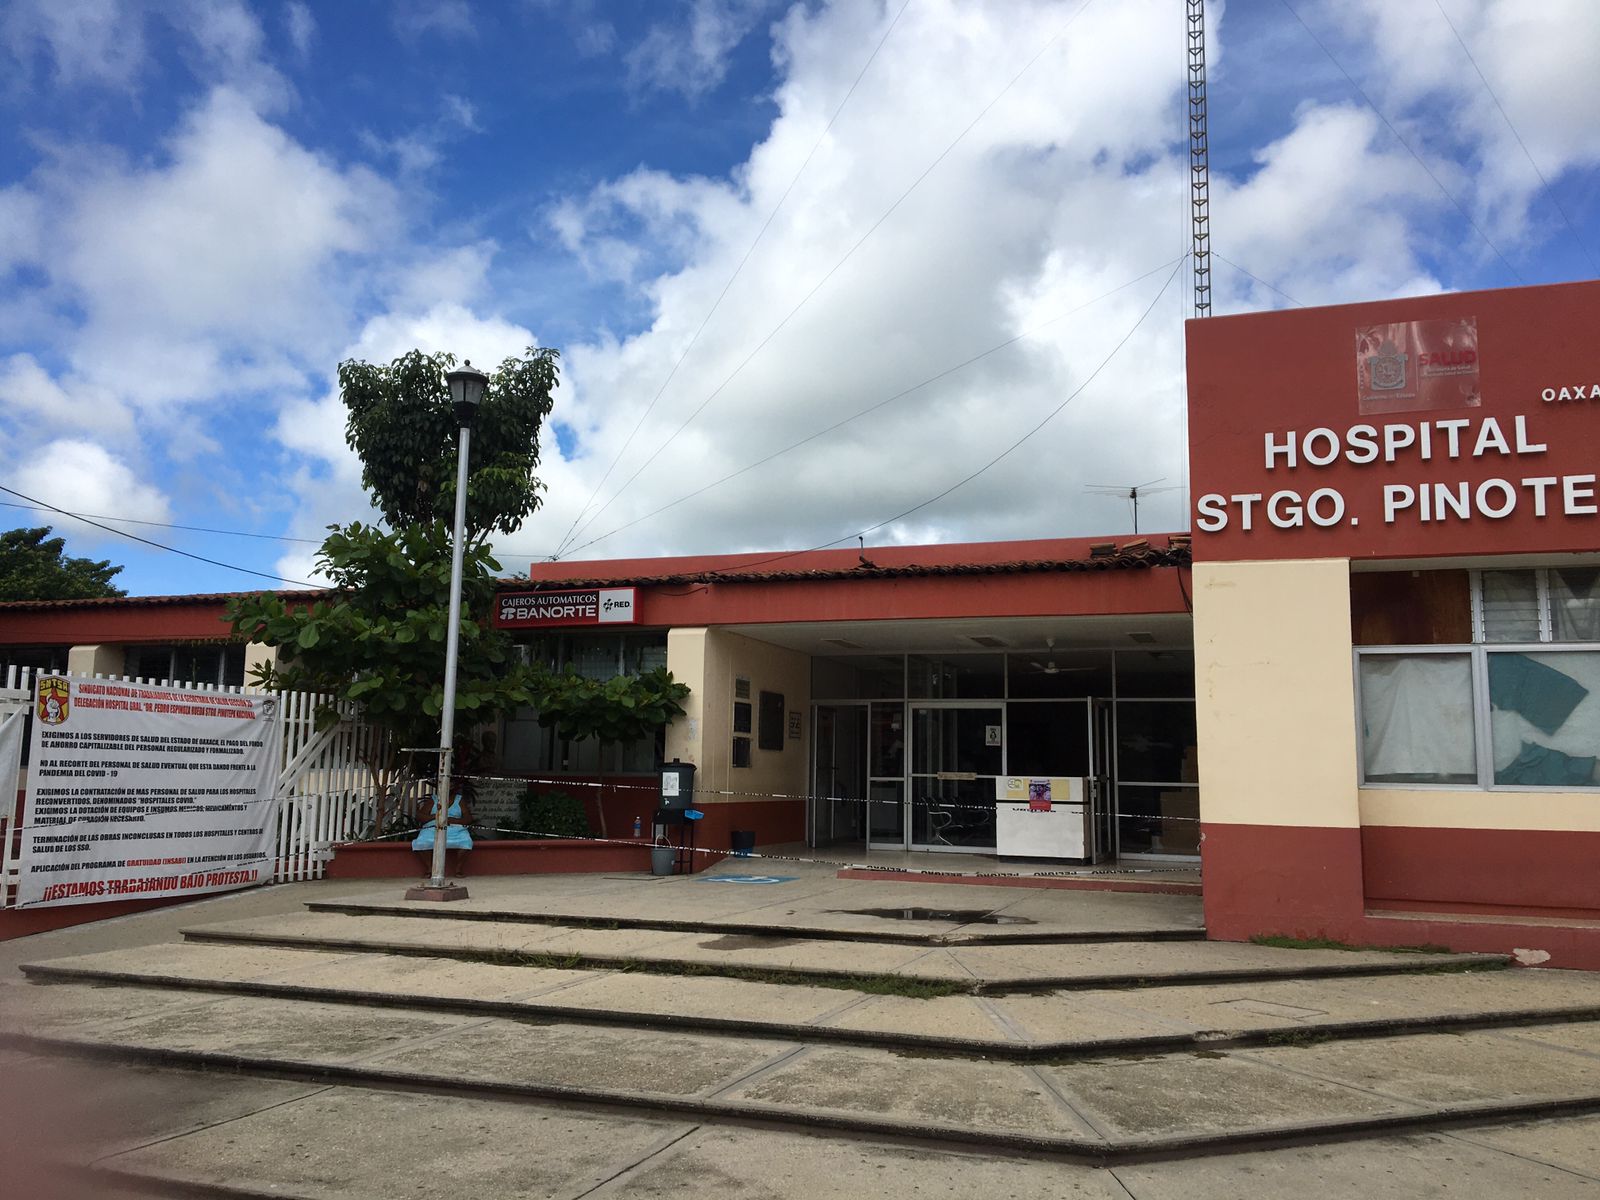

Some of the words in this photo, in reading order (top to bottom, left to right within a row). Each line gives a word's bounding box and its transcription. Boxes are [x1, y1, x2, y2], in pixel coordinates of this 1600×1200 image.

[1418, 350, 1477, 366] SALUD
[1264, 414, 1548, 470] HOSPITAL
[1195, 486, 1359, 533] STGO.
[1382, 473, 1599, 524] PINOTE
[501, 596, 536, 607] CAJEROS
[536, 594, 597, 605] AUTOMATICOS
[516, 605, 596, 620] BANORTE
[39, 679, 69, 692] SNTSA
[78, 683, 105, 695] SINDICATO
[106, 686, 130, 697] NACIONAL
[130, 688, 137, 698] DE
[73, 697, 104, 709] DELEGACIÓN
[105, 699, 129, 710] HOSPITAL
[154, 702, 170, 714] PEDRO
[41, 731, 74, 739] EXIGIMOS
[93, 733, 130, 742] SERVIDORES
[140, 735, 159, 743] SALUD
[50, 741, 78, 749] AHORRO
[79, 742, 123, 750] CAPITALIZABLE
[135, 744, 166, 752] PERSONAL
[166, 745, 205, 753] REGULARIZADO
[209, 747, 244, 755] FORMALIZADO.
[59, 760, 88, 768] RECORTE
[89, 760, 100, 768] DEL
[100, 760, 131, 768] PERSONAL
[132, 761, 140, 769] DE
[141, 761, 160, 769] SALUD
[160, 762, 188, 770] EVENTUAL
[38, 769, 73, 777] PANDEMIA
[74, 769, 85, 777] DEL
[86, 769, 106, 777] COVID
[110, 770, 118, 778] 19
[80, 787, 126, 795] CONTRATACIÓN
[92, 797, 136, 805] DENOMINADOS
[78, 806, 109, 814] DOTACIÓN
[33, 816, 67, 825] MATERIAL
[33, 835, 78, 844] TERMINACIÓN
[99, 833, 121, 841] OBRAS
[204, 829, 233, 837] HOSPITALES
[32, 845, 54, 853] SALUD
[30, 864, 70, 873] APLICACIÓN
[81, 861, 117, 869] PROGRAMA
[117, 860, 126, 868] DE
[126, 858, 161, 866] GRATUIDAD
[201, 854, 227, 863] ATENCIÓN
[180, 873, 204, 889] BAJO
